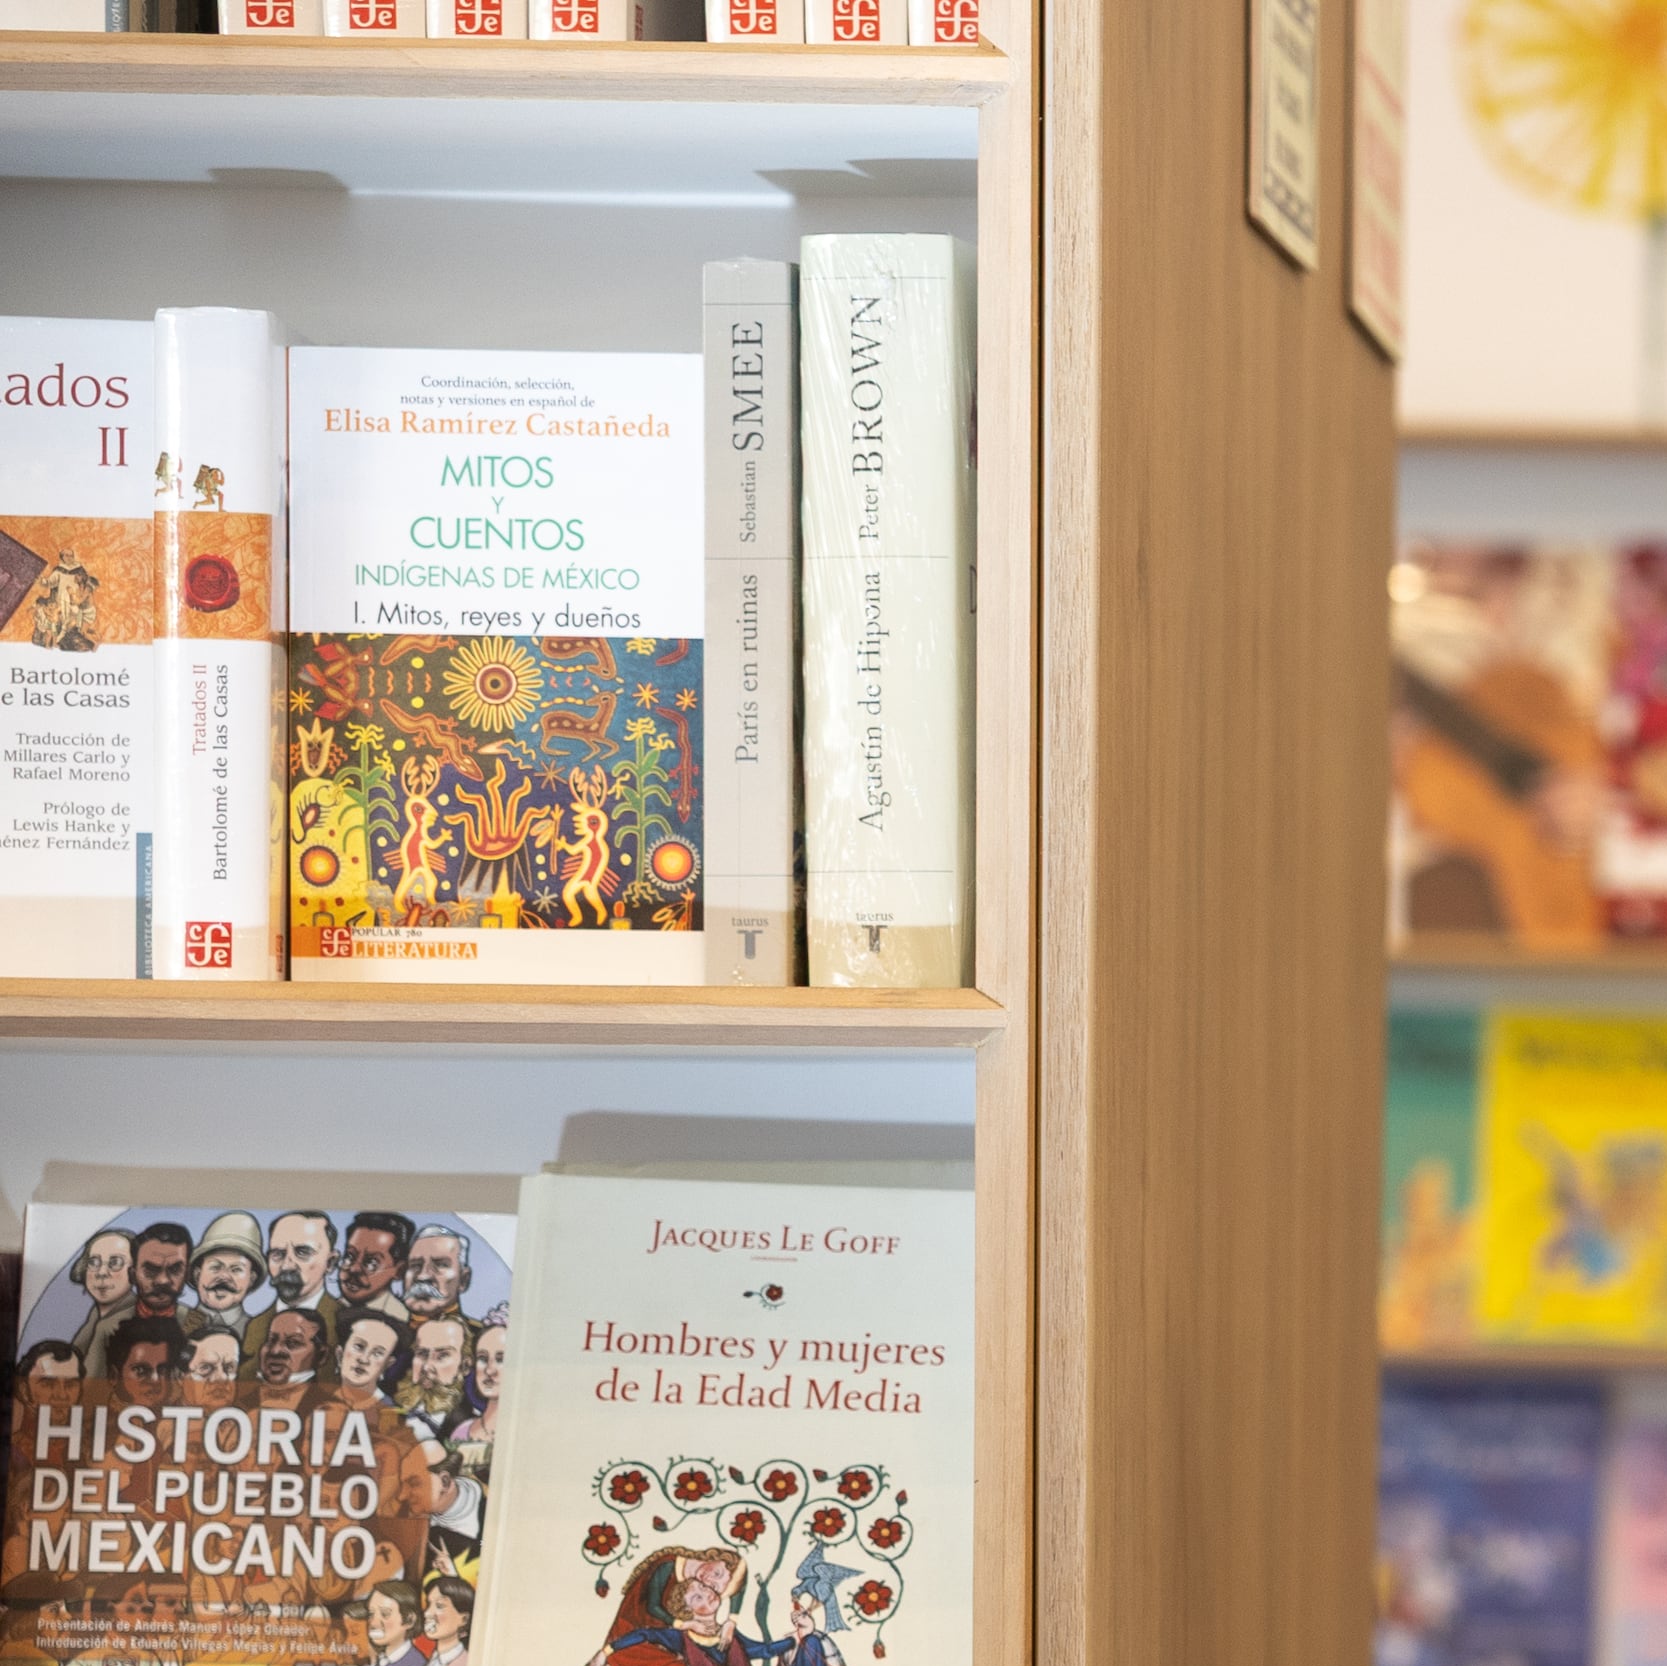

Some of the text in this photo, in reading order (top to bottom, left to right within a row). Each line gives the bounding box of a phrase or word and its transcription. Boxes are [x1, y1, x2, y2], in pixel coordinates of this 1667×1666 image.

[420, 375, 576, 392] Coordinación, selección,
[731, 321, 763, 451] SMEE
[851, 295, 883, 475] BROWN
[400, 393, 596, 410] notas y versiones en español de
[324, 408, 671, 438] Elisa Ramírez Castañeda
[98, 426, 129, 467] II
[440, 455, 554, 488] MITOS
[491, 497, 504, 514] Y
[740, 460, 756, 543] Sebastian
[410, 516, 585, 551] CUENTOS
[355, 559, 640, 590] INDÍGENAS DE MÉXICO
[377, 601, 449, 629] Mitos,
[460, 606, 522, 633] reyes
[531, 609, 545, 633] y
[554, 603, 641, 629] dueños
[857, 572, 889, 675] Hipona
[10, 667, 130, 687] Bartolomé
[735, 574, 758, 763] París en ruinas
[23, 688, 130, 708] las Casas
[192, 677, 207, 755] Tratados
[16, 733, 130, 747] Traducción de
[13, 767, 131, 781] Rafael Moreno
[73, 751, 115, 764] Carlo
[121, 755, 130, 767] y
[213, 664, 228, 880] Bartolomé de las Casas
[858, 726, 891, 831] Agustín
[43, 802, 130, 819] Prólogo de
[13, 819, 130, 836] Lewis Hanke y
[47, 837, 130, 850] Fernández
[731, 917, 769, 926] taurus
[351, 942, 477, 959] LITERATURA
[583, 1320, 945, 1374] Hombres y mujeres
[595, 1367, 921, 1414] de la Edad Media
[34, 1404, 377, 1468] HISTORIA
[32, 1468, 379, 1520] DEL PUEBLO
[28, 1520, 377, 1579] MEXICANO
